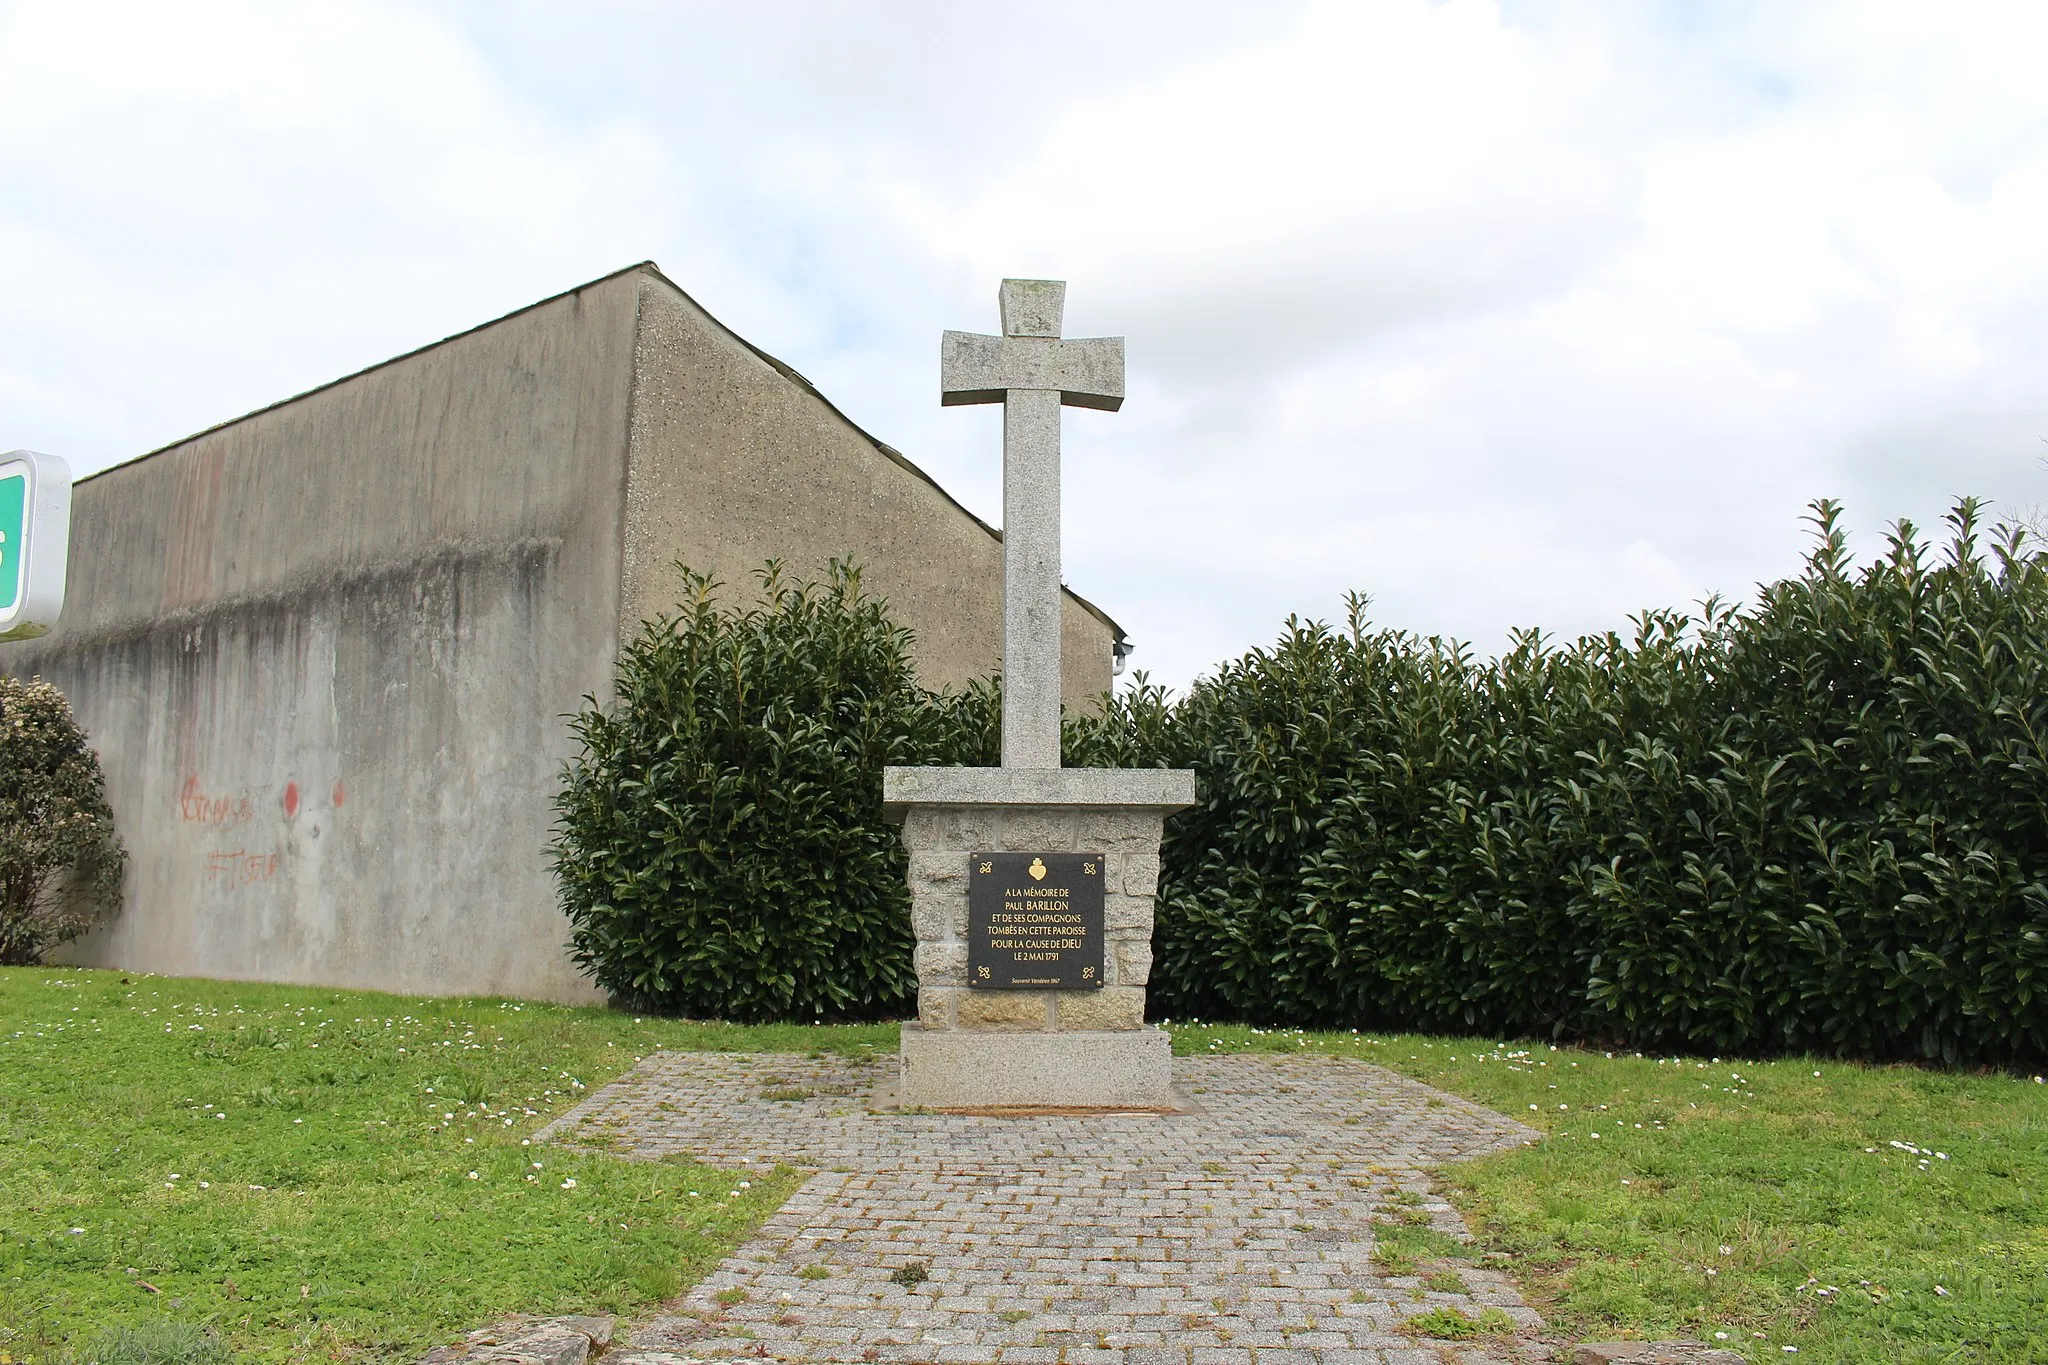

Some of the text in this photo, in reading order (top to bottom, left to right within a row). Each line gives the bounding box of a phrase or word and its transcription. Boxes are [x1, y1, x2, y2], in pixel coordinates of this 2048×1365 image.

[1005, 887, 1069, 897] A LA MÉMOIRE DE
[1005, 901, 1069, 910] PAUL BARILLON
[992, 914, 1081, 923] ET DE SES COMPAGNONS
[988, 924, 1086, 935] TOMBÉS EN CETTE PAROISSE
[991, 938, 1082, 949] POUR LA CAUSE DE DIEU
[1014, 952, 1059, 960] LE 2 MAI 1791
